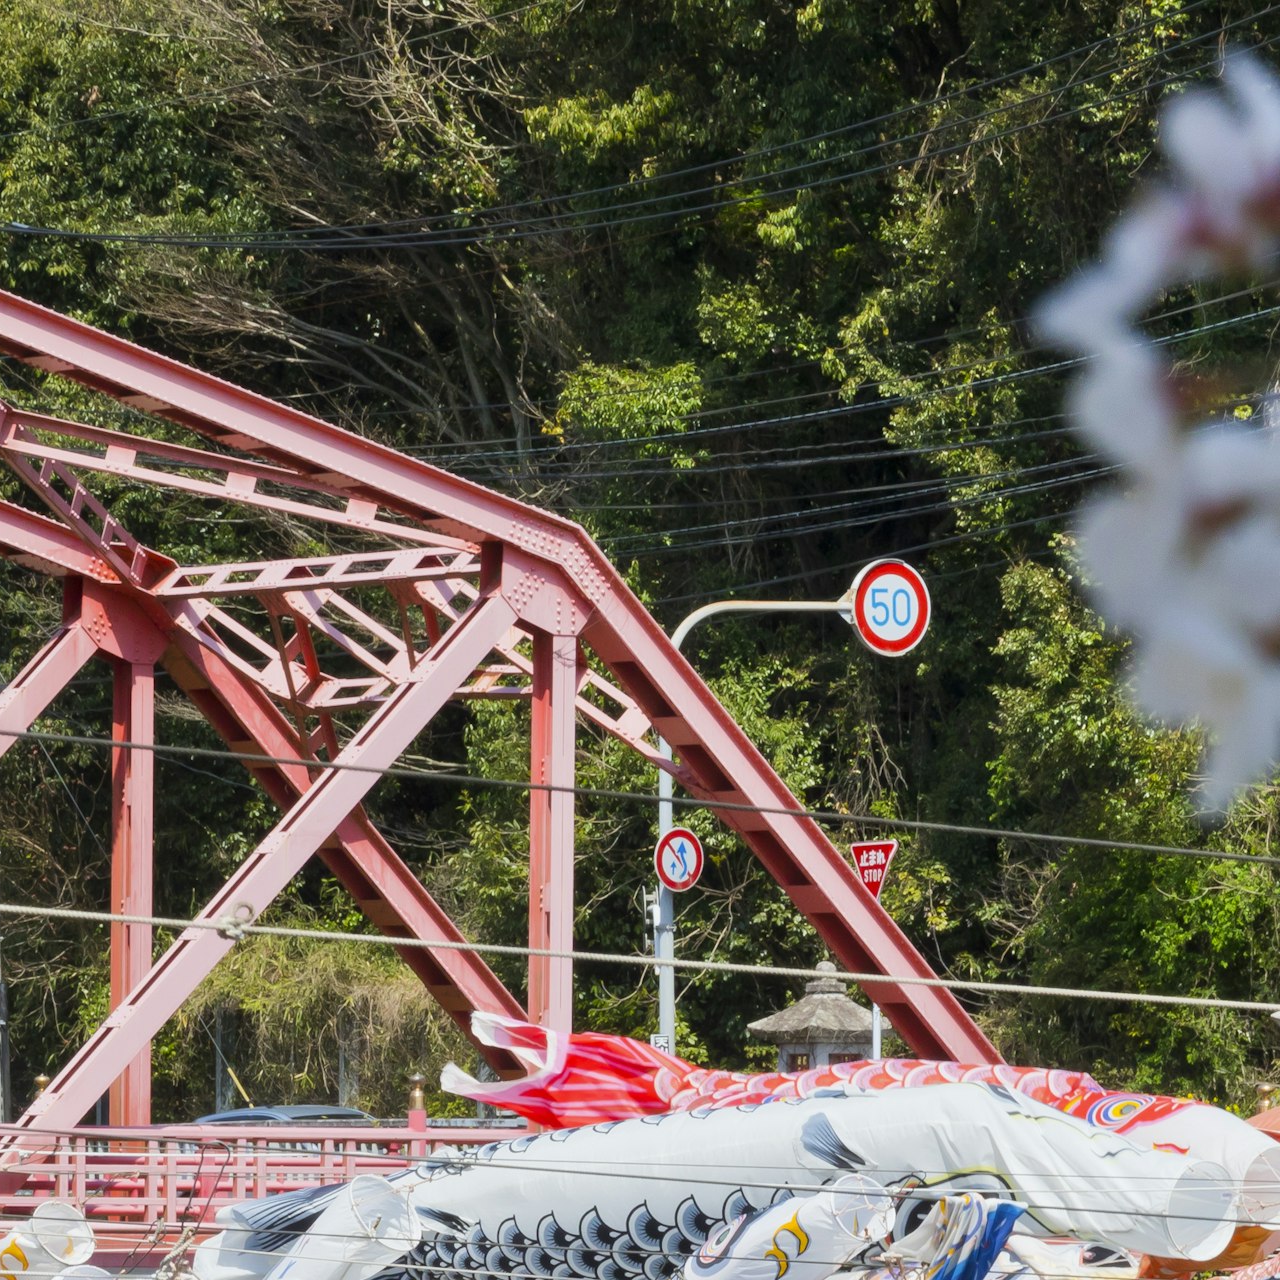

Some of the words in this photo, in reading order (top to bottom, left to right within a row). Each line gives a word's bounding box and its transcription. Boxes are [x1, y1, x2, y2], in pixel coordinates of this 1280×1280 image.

[871, 588, 911, 627] 50
[859, 849, 886, 867] 止まれ
[863, 868, 882, 883] STOP
